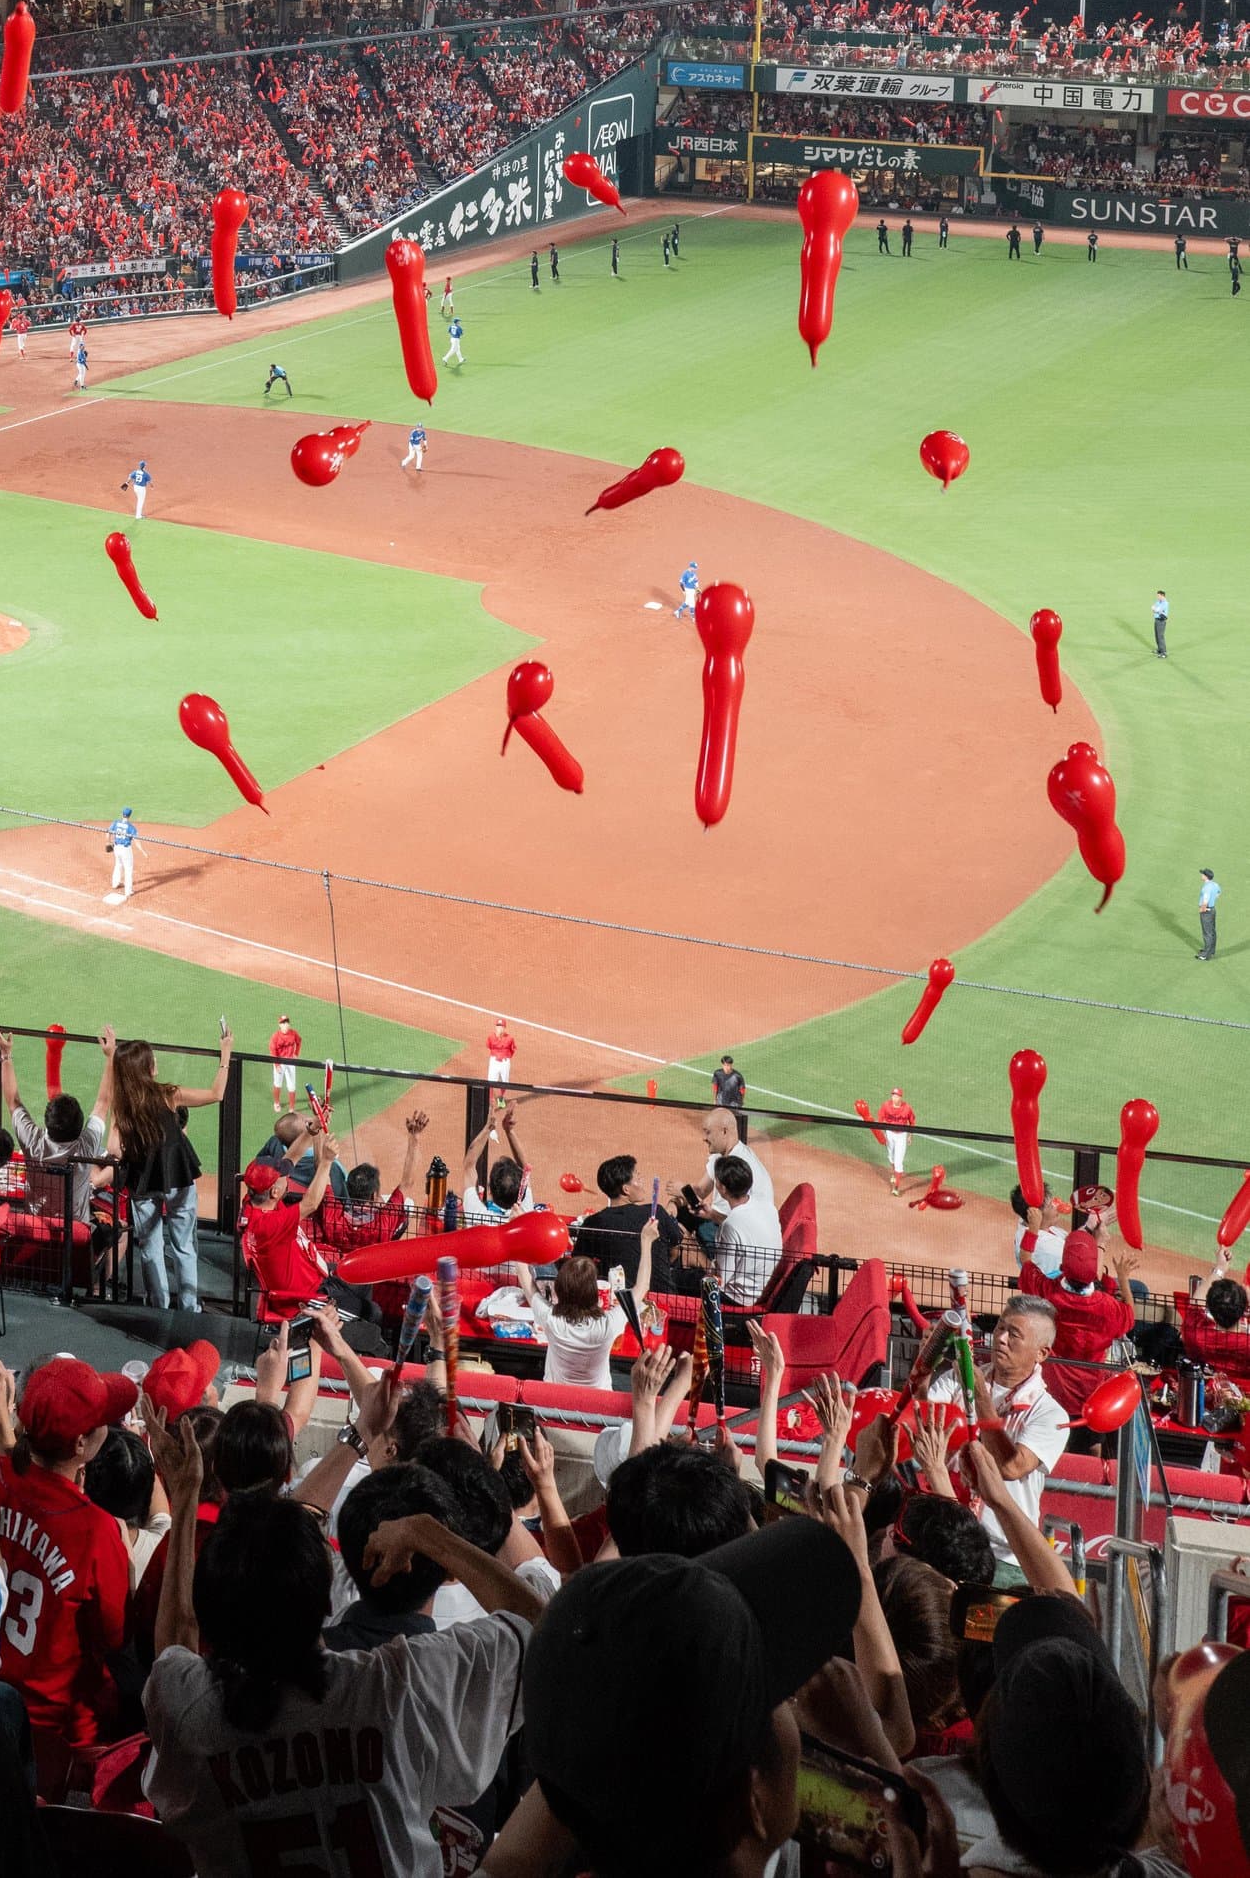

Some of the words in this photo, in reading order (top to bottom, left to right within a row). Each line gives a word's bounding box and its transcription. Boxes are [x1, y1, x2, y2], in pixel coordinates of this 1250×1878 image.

[688, 72, 741, 84] アスカネット
[811, 73, 904, 96] 双葉運輸
[908, 83, 951, 98] グループ
[1033, 83, 1143, 111] 中国電力
[1180, 91, 1250, 116] CGC
[668, 135, 739, 153] JR西日本
[491, 155, 530, 182] 神話の里
[804, 145, 922, 171] シマヤだしの素
[448, 175, 533, 241] 仁多米
[1070, 197, 1218, 230] SUNSTAR
[90, 261, 159, 275] 共立械製作所
[2, 1564, 44, 1656] 3
[208, 1727, 383, 1810] KOZONO
